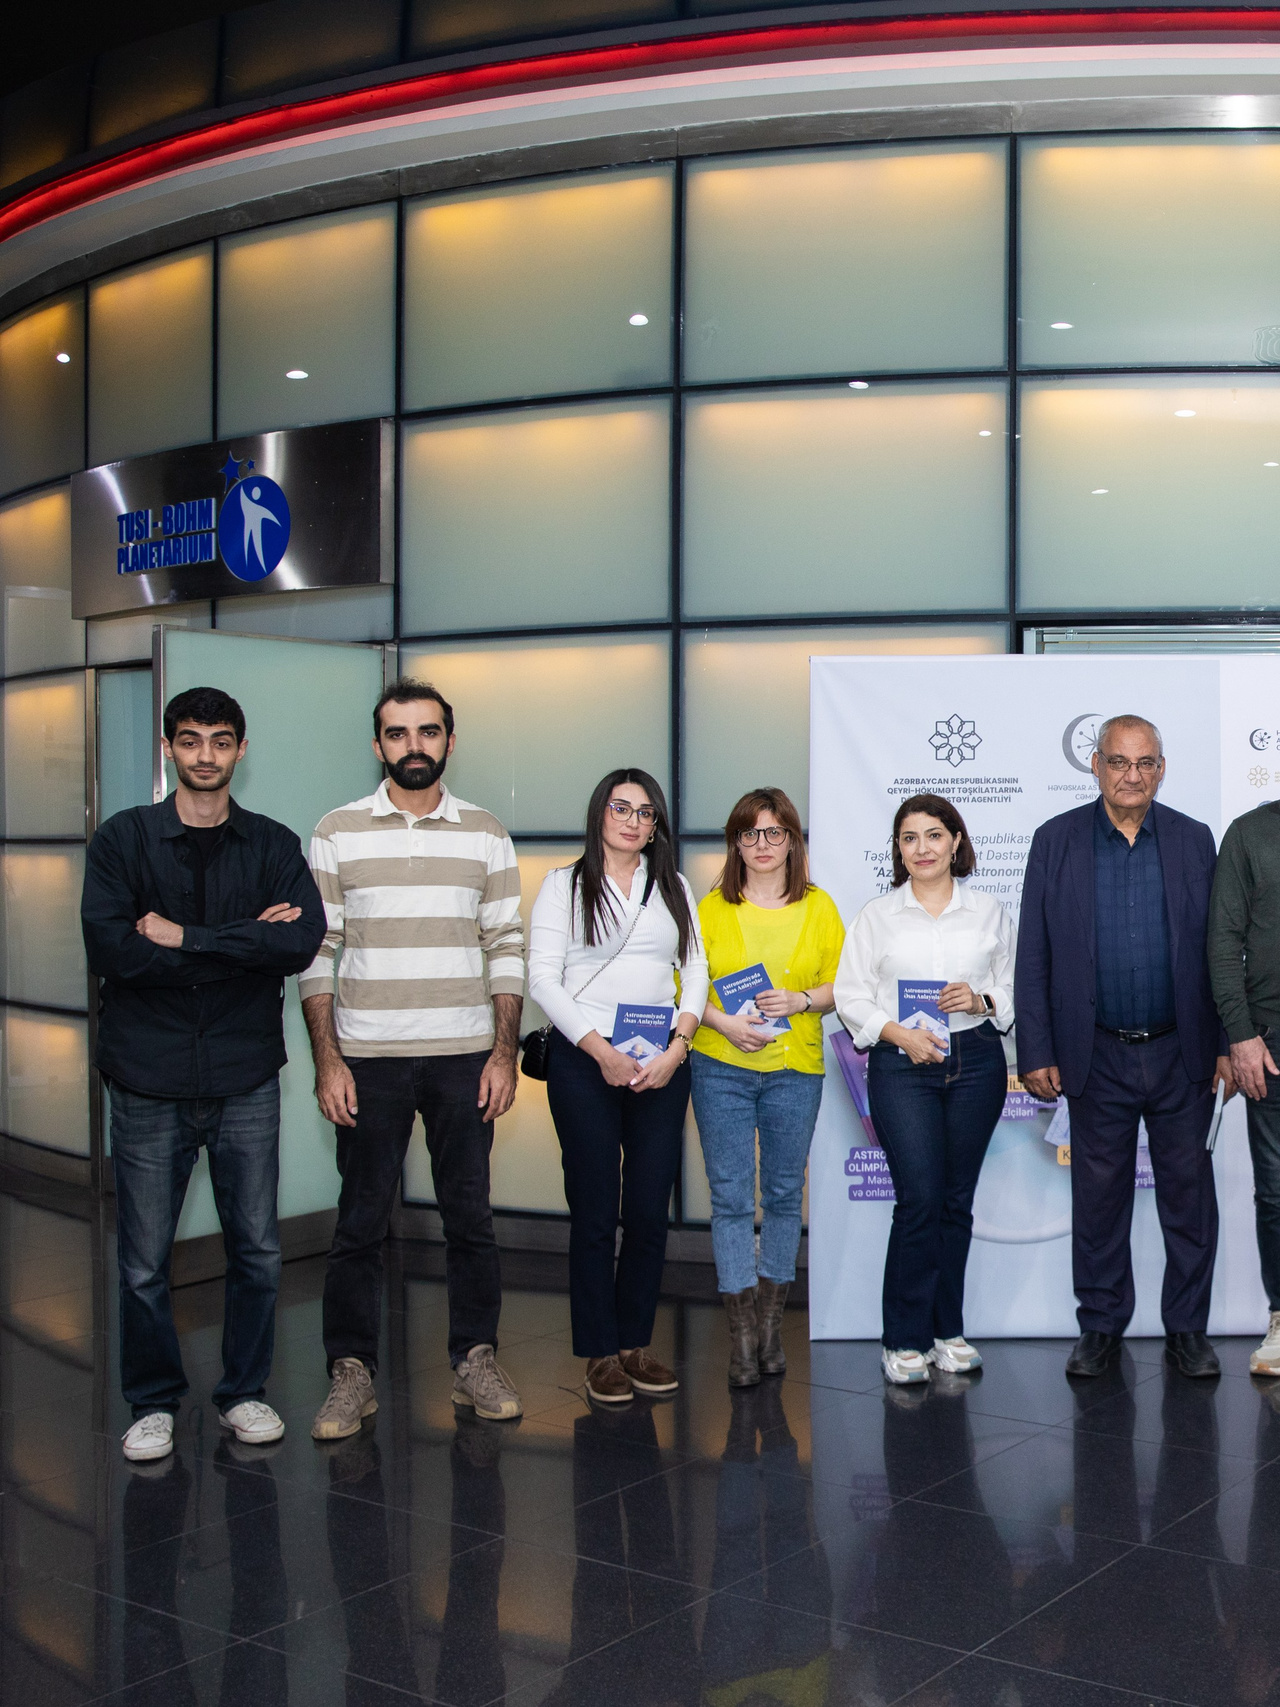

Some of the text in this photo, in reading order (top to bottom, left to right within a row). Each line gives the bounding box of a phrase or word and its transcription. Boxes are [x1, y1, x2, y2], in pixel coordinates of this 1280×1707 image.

[117, 509, 151, 544] TUSI
[162, 498, 216, 535] BOHM
[117, 532, 216, 575] PLANETARIUM
[950, 776, 1019, 785] RESPUBLİKASININ
[887, 786, 1023, 796] QEYRİ-HÖKUMƏT TƏŞKİLATLARINA
[1075, 792, 1098, 800] CƏMİY
[946, 795, 1012, 803] STƏYİ AGENTLİYİ
[969, 833, 1031, 846] espublikas
[986, 850, 1029, 863] Dəstəy
[1002, 1107, 1034, 1119] Elçiləri
[848, 1161, 890, 1172] OLİMPİA
[852, 1189, 863, 1197] və
